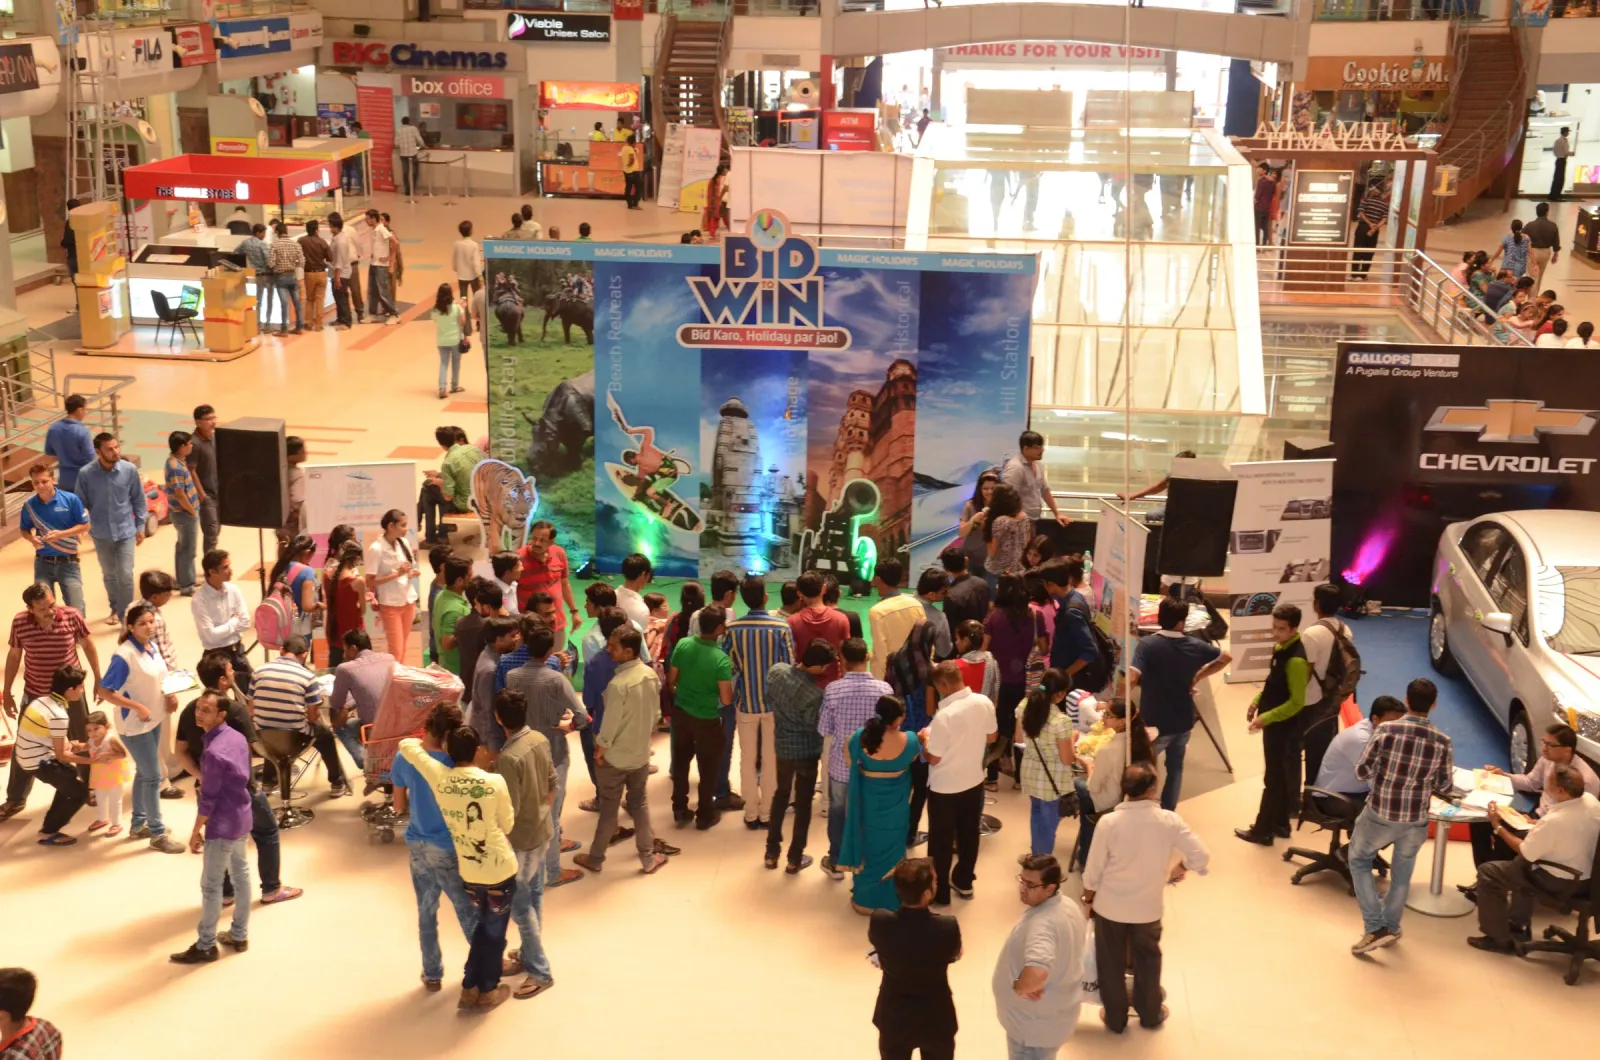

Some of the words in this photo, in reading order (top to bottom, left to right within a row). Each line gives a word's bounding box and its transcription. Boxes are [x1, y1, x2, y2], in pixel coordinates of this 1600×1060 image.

[544, 29, 578, 38] Unisex
[580, 29, 609, 39] Salon
[132, 38, 163, 62] FILA
[333, 42, 389, 65] BIG
[391, 43, 508, 68] Cinemas
[948, 44, 1017, 57] THANKS
[1022, 44, 1058, 57] FOR
[1063, 45, 1114, 58] YOUR
[1118, 46, 1161, 58] VISIT
[1343, 61, 1409, 83] Cookie
[411, 78, 444, 94] box
[448, 79, 493, 96] office
[840, 116, 859, 125] ATM
[1267, 132, 1407, 150] HIMALAYA
[156, 187, 173, 197] THE
[207, 188, 234, 199] STORE
[493, 245, 525, 255] MAGIC
[527, 246, 571, 256] HOLIDAYS
[594, 248, 626, 257] MAGIC
[628, 249, 672, 259] HOLIDAYS
[724, 236, 816, 279] BID
[837, 253, 870, 264] MAGIC
[872, 255, 918, 266] HOLIDAYS
[942, 258, 975, 268] MAGIC
[977, 260, 1024, 270] HOLIDAYS
[761, 281, 774, 289] TO
[609, 275, 622, 341] Retreats
[690, 279, 821, 327] WIN
[691, 328, 711, 341] Bid
[713, 330, 743, 342] Karo,
[746, 331, 792, 344] Holiday
[794, 333, 814, 344] par
[816, 331, 838, 344] jao!
[1001, 316, 1020, 380] Station
[1349, 353, 1411, 365] GALLOPS
[609, 345, 623, 392] Beach
[1346, 367, 1354, 375] A
[1355, 367, 1389, 378] Pugalia
[1391, 369, 1421, 379] Group
[1423, 369, 1458, 378] Venture
[1000, 386, 1016, 414] Hill
[1419, 453, 1598, 475] CHEVROLET
